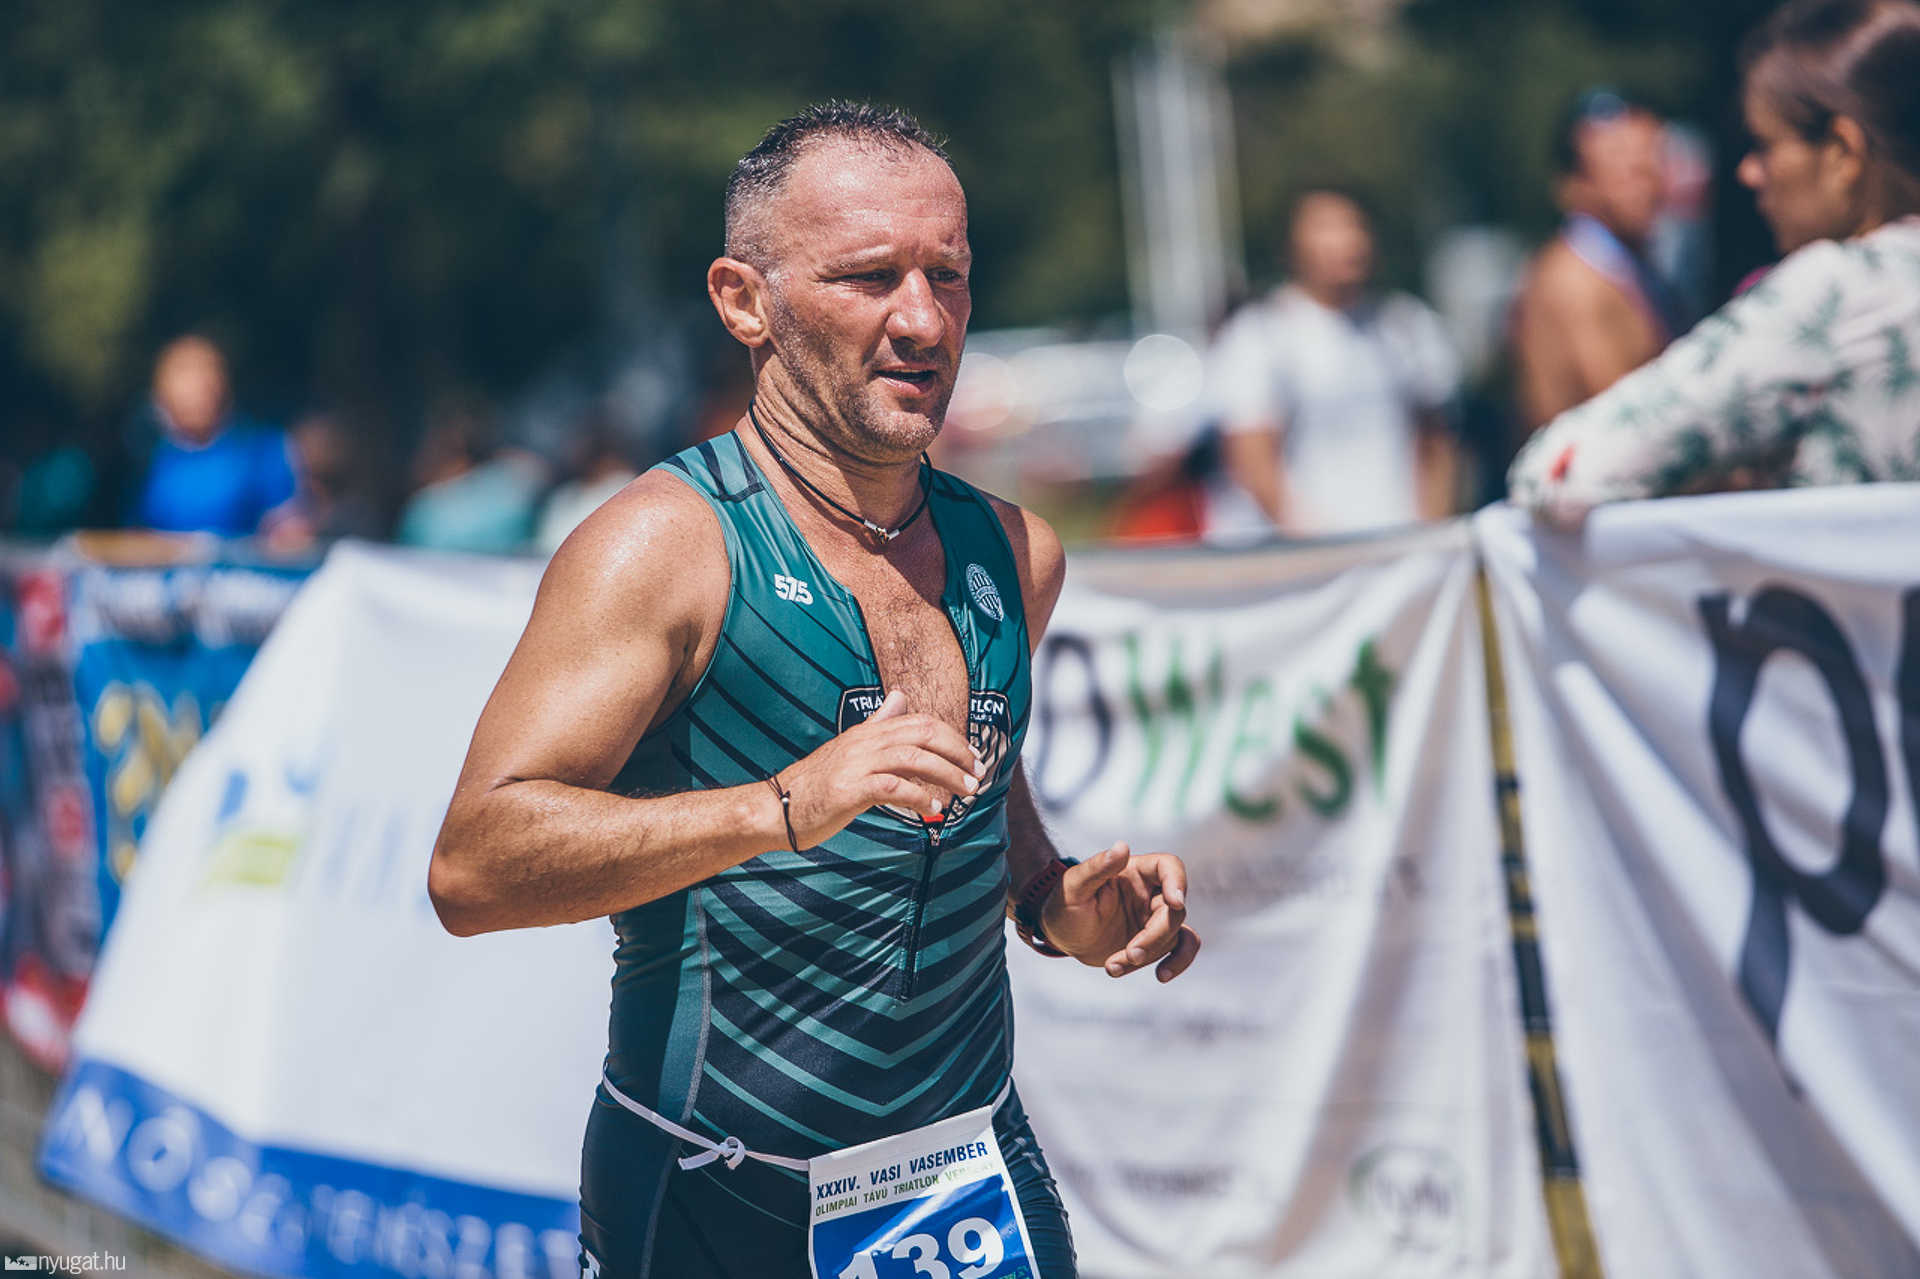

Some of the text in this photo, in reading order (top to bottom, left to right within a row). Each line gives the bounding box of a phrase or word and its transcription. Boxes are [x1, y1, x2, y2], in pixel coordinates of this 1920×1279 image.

[773, 573, 814, 605] 575
[815, 1175, 861, 1201] XXXIV.
[869, 1163, 901, 1185] VASI
[909, 1141, 988, 1174] VASEMBER
[815, 1195, 858, 1217] OLIMPIAI
[893, 1174, 940, 1195] TRIATLON
